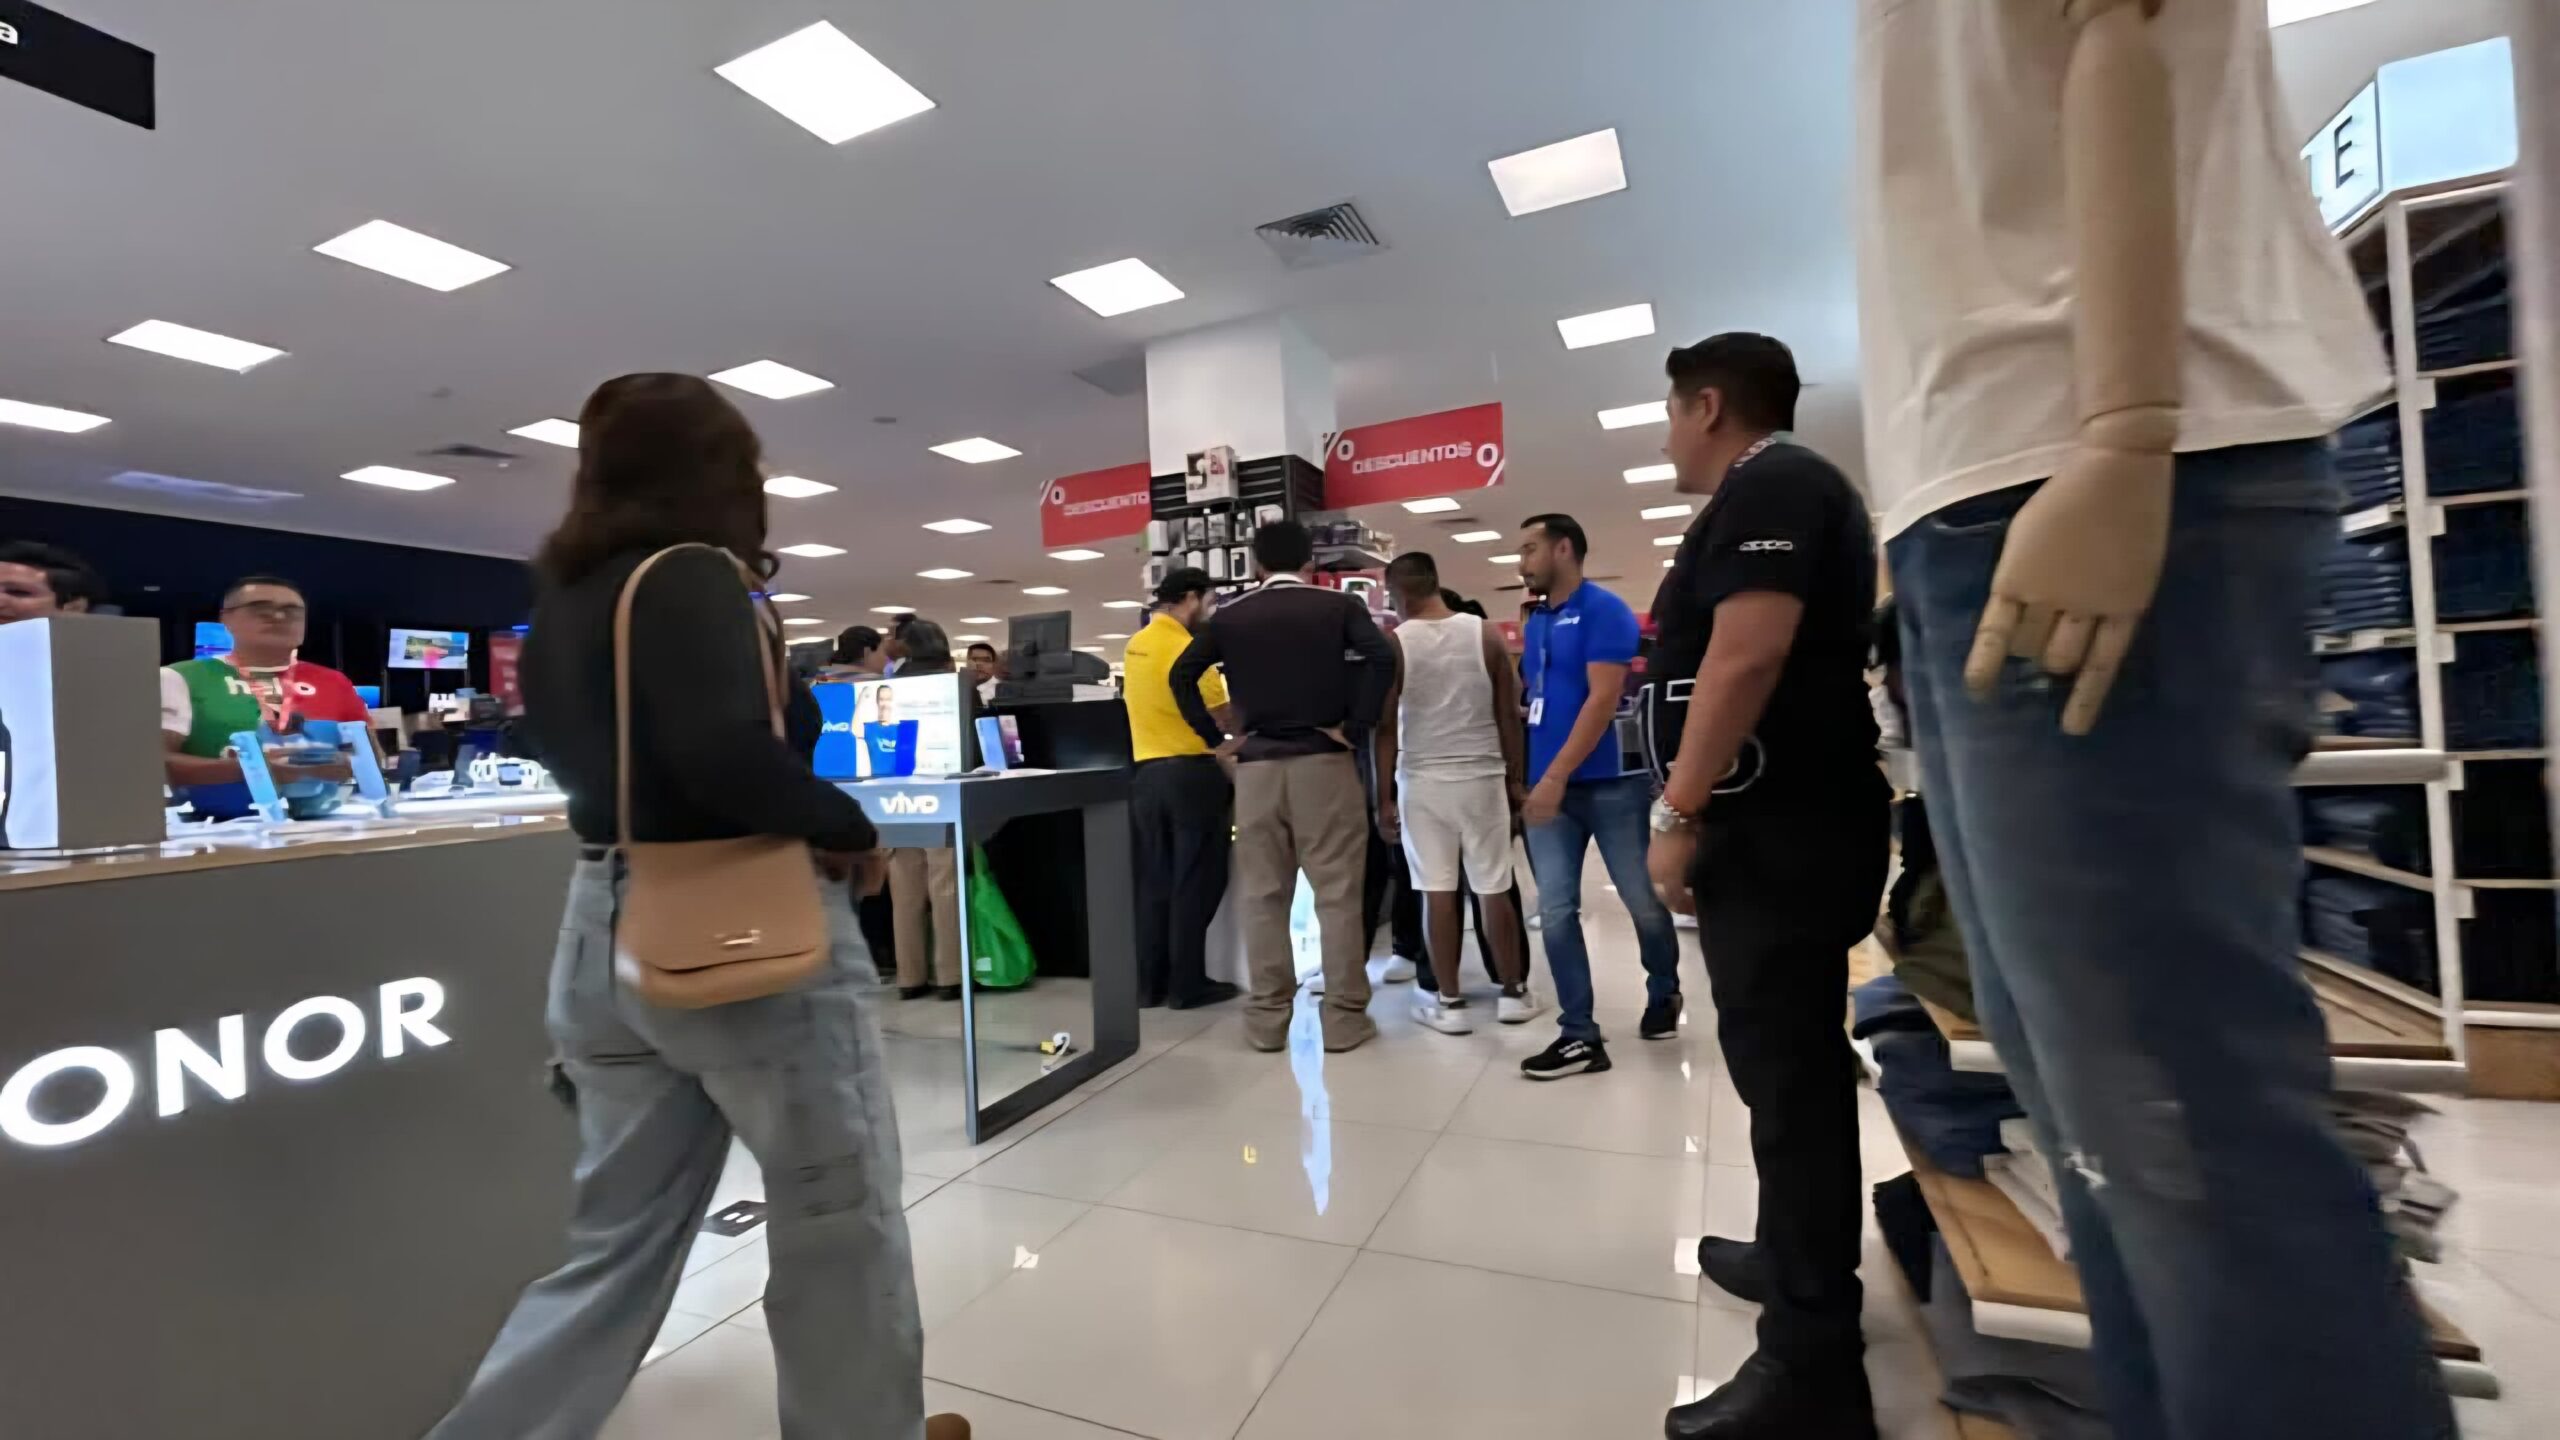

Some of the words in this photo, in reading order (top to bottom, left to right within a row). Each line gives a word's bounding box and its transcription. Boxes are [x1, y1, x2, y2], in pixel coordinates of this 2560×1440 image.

[1352, 441, 1472, 474] DESCUENTOS
[880, 791, 939, 814] vivo
[0, 976, 451, 1147] ONOR
